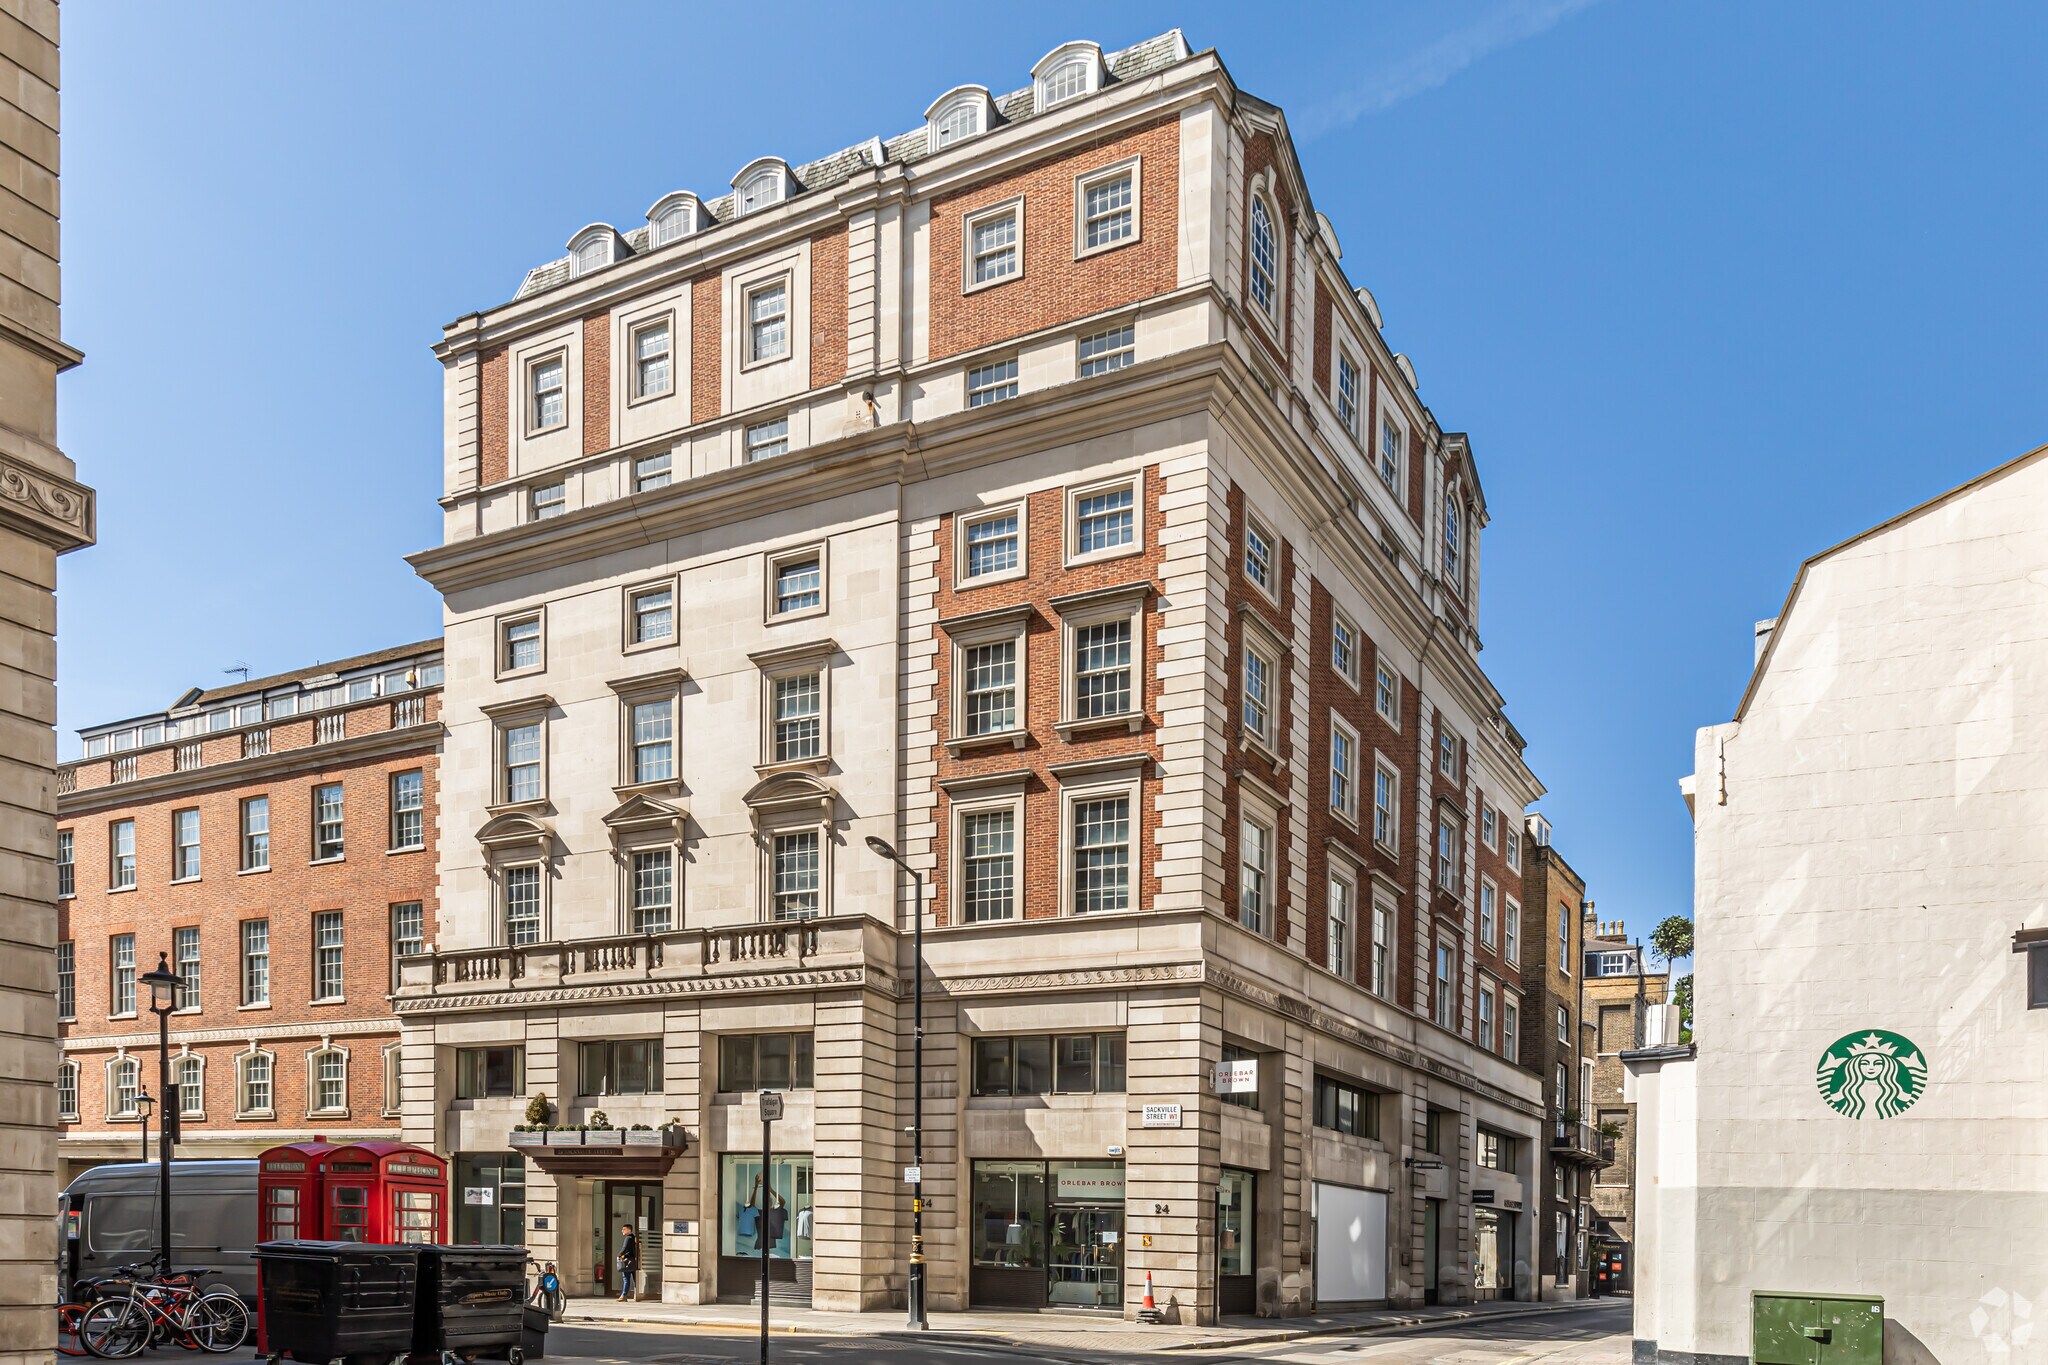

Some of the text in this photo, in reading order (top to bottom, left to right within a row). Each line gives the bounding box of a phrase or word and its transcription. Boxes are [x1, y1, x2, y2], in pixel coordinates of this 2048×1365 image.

[1218, 1070, 1254, 1078] ORLEBAR
[761, 1098, 778, 1107] Trafalgar
[764, 1108, 777, 1117] Square
[390, 1163, 439, 1176] TELEPHONE
[1154, 1203, 1170, 1215] 24
